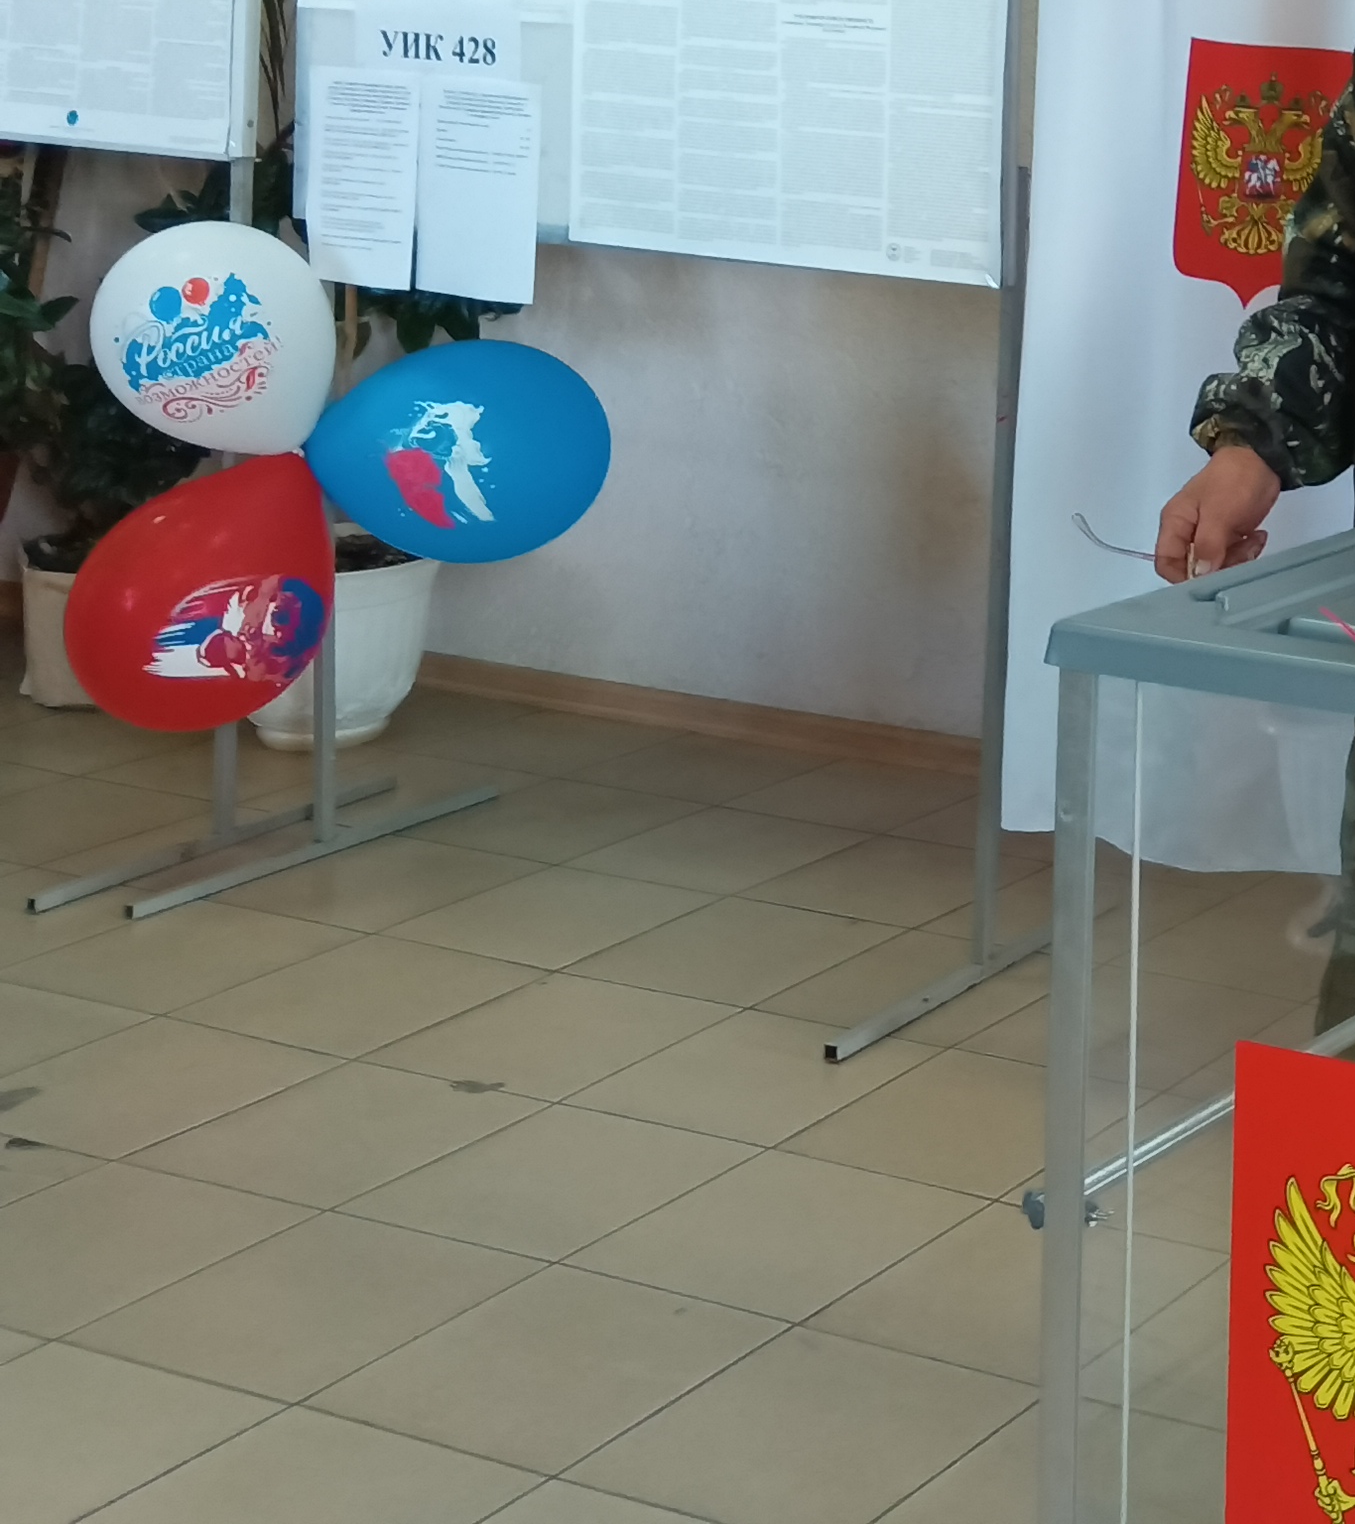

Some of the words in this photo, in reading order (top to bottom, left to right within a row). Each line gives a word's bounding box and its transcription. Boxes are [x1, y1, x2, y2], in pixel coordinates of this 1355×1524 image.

[379, 29, 445, 62] УИК
[451, 35, 497, 66] 428
[121, 314, 244, 378] Россия
[162, 341, 239, 382] страна
